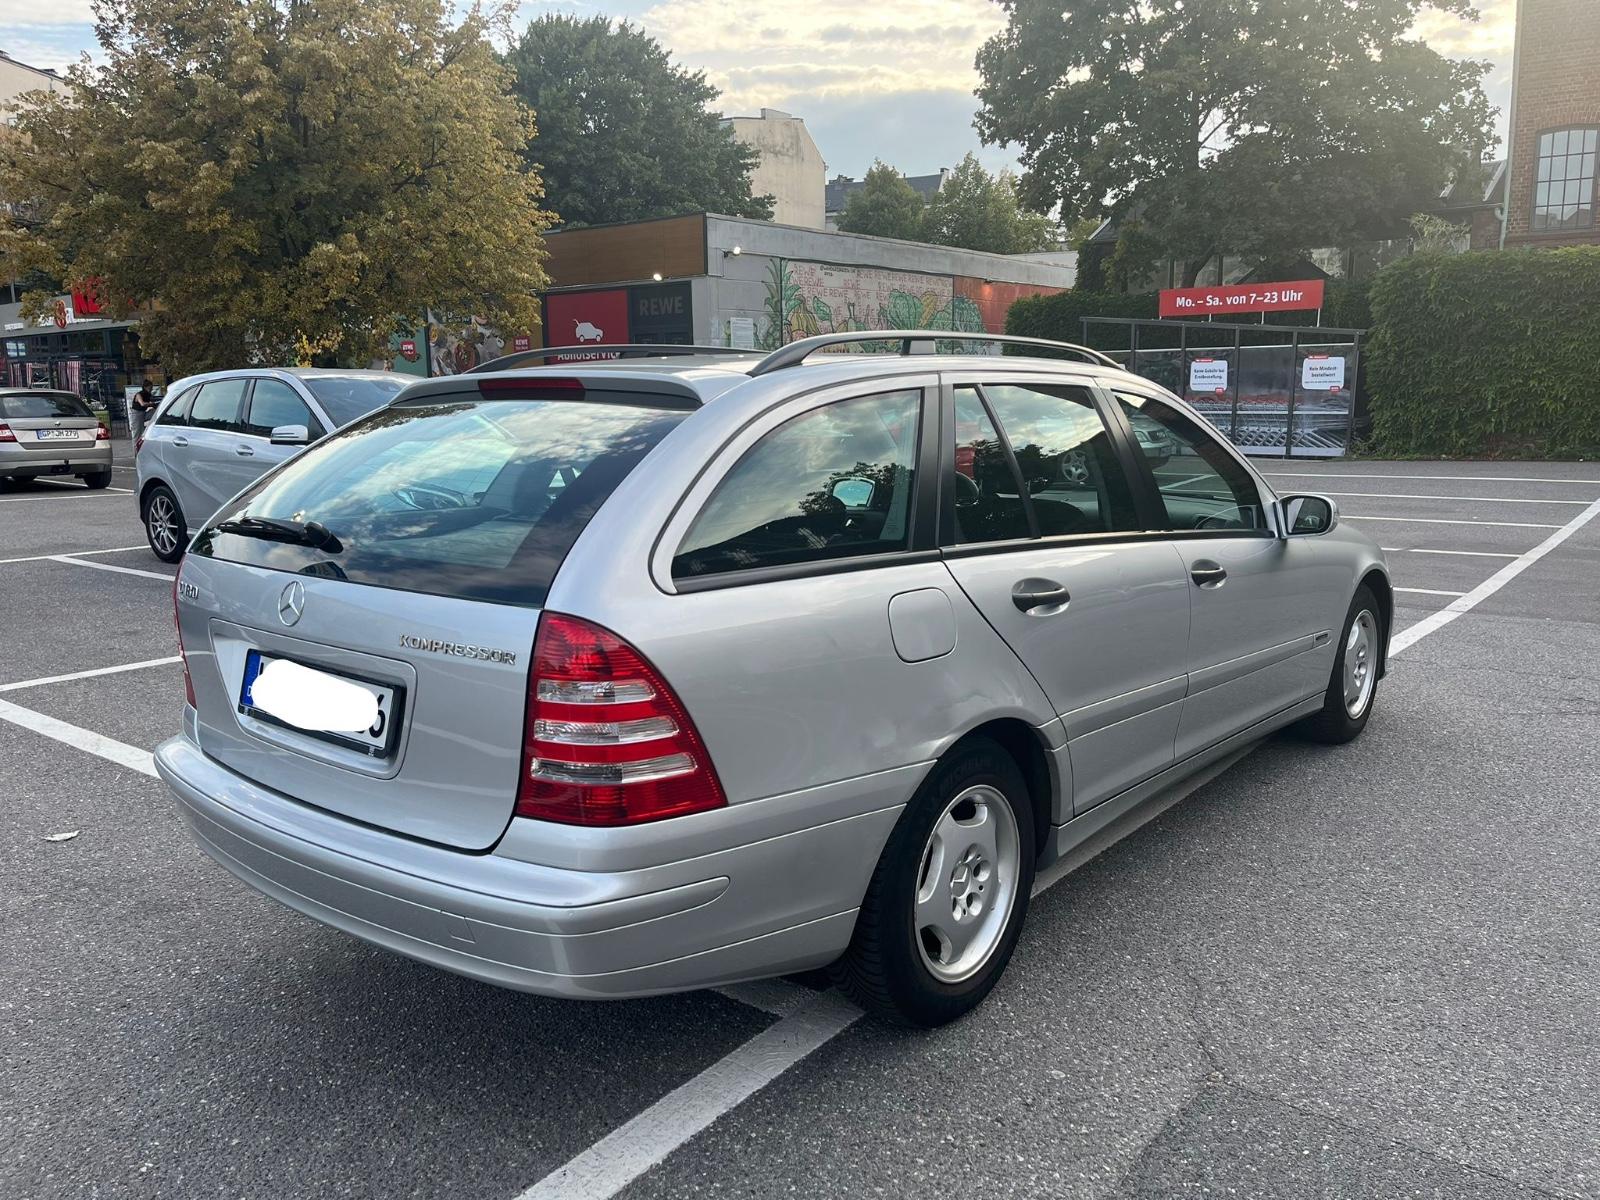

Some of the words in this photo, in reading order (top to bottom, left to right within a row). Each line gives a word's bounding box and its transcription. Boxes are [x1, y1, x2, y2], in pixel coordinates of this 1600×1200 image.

[640, 296, 684, 316] REWE
[1176, 296, 1195, 307] Mo.
[1206, 294, 1223, 306] Sa.
[1226, 295, 1246, 305] von
[1281, 289, 1303, 302] Uhr
[399, 633, 517, 666] KOMPRESSOR
